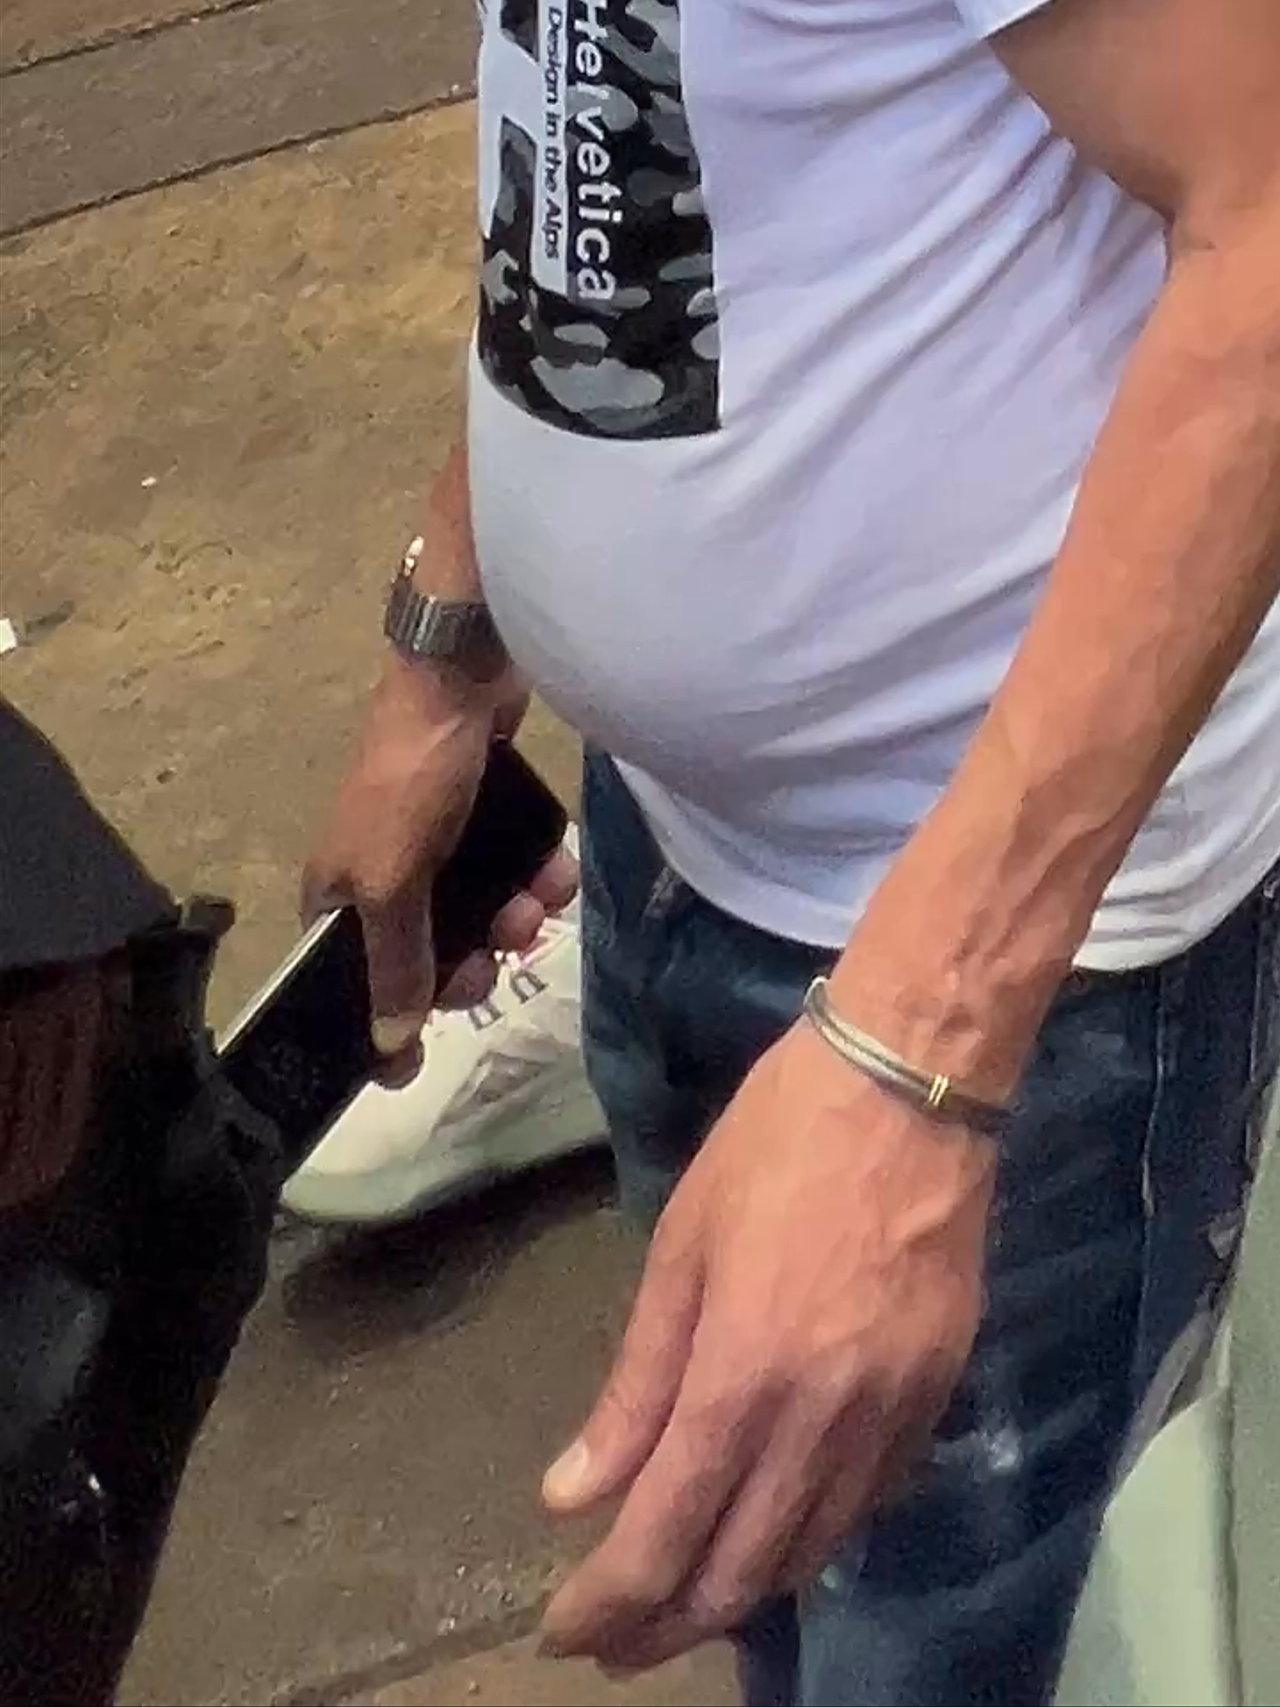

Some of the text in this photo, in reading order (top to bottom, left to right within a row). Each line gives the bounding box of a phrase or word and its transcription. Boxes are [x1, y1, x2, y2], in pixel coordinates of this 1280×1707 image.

[541, 5, 564, 260] Design in the Alps
